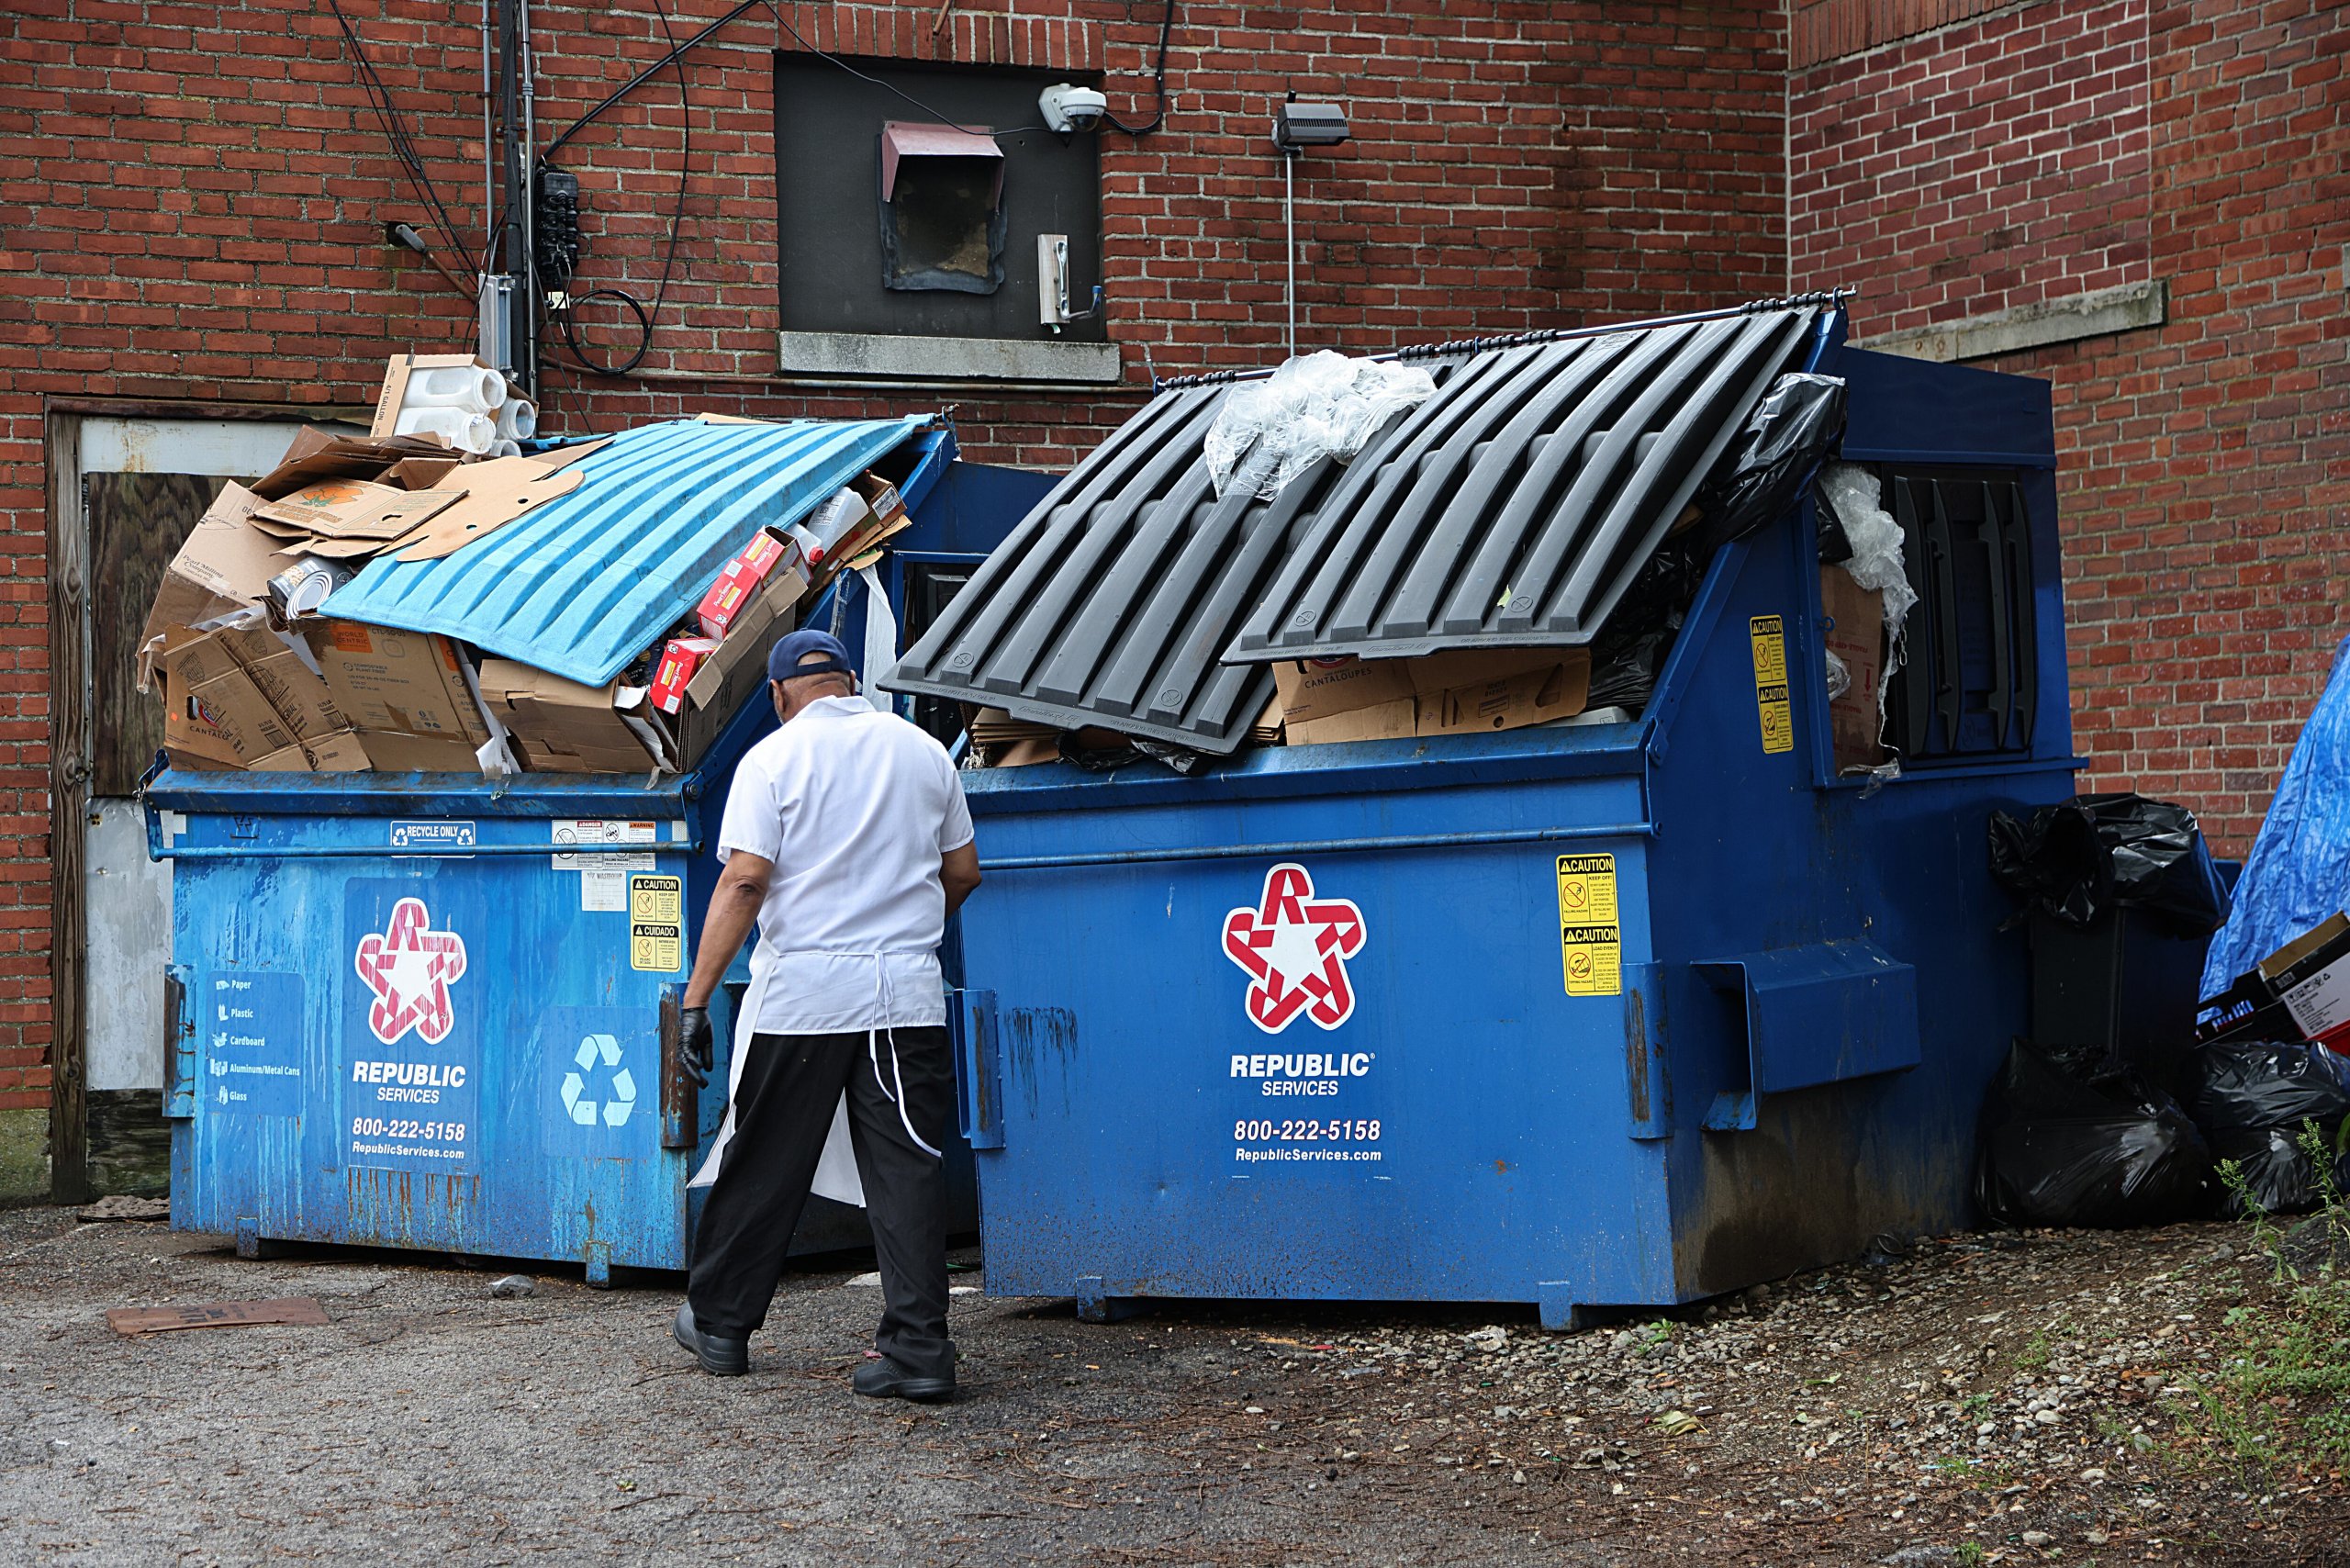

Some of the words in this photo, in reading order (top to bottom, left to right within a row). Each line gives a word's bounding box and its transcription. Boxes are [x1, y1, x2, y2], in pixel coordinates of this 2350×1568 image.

[378, 396, 389, 420] GALLON
[184, 561, 215, 579] Company
[200, 563, 224, 579] Milling
[1758, 620, 1782, 633] CAUTION
[1304, 666, 1372, 689] CANTALOUPES
[1764, 688, 1788, 701] CAUTION
[189, 725, 228, 741] CANTALO
[407, 825, 439, 837] RECYCLE
[441, 825, 458, 837] ONLY
[1571, 857, 1613, 872] CAUTION
[643, 879, 677, 890] CAUTION
[644, 925, 675, 936] CUIDADO
[1575, 928, 1617, 943] CAUTION
[231, 980, 252, 991] Paper
[230, 1008, 253, 1018] Plastic
[230, 1036, 265, 1047] Cardboard
[229, 1064, 284, 1075] Aluminum/Metal
[284, 1066, 300, 1076] Cans
[352, 1060, 466, 1088] REPUBLIC
[229, 1091, 247, 1101] Glass
[376, 1087, 440, 1103] SERVICES
[1261, 1081, 1338, 1096] SERVICES
[352, 1117, 465, 1142] 800-222-5158
[1234, 1119, 1382, 1141] 800-222-5158
[352, 1141, 465, 1159] RepublicServices.com
[1235, 1148, 1382, 1163] RepublicServices.com
